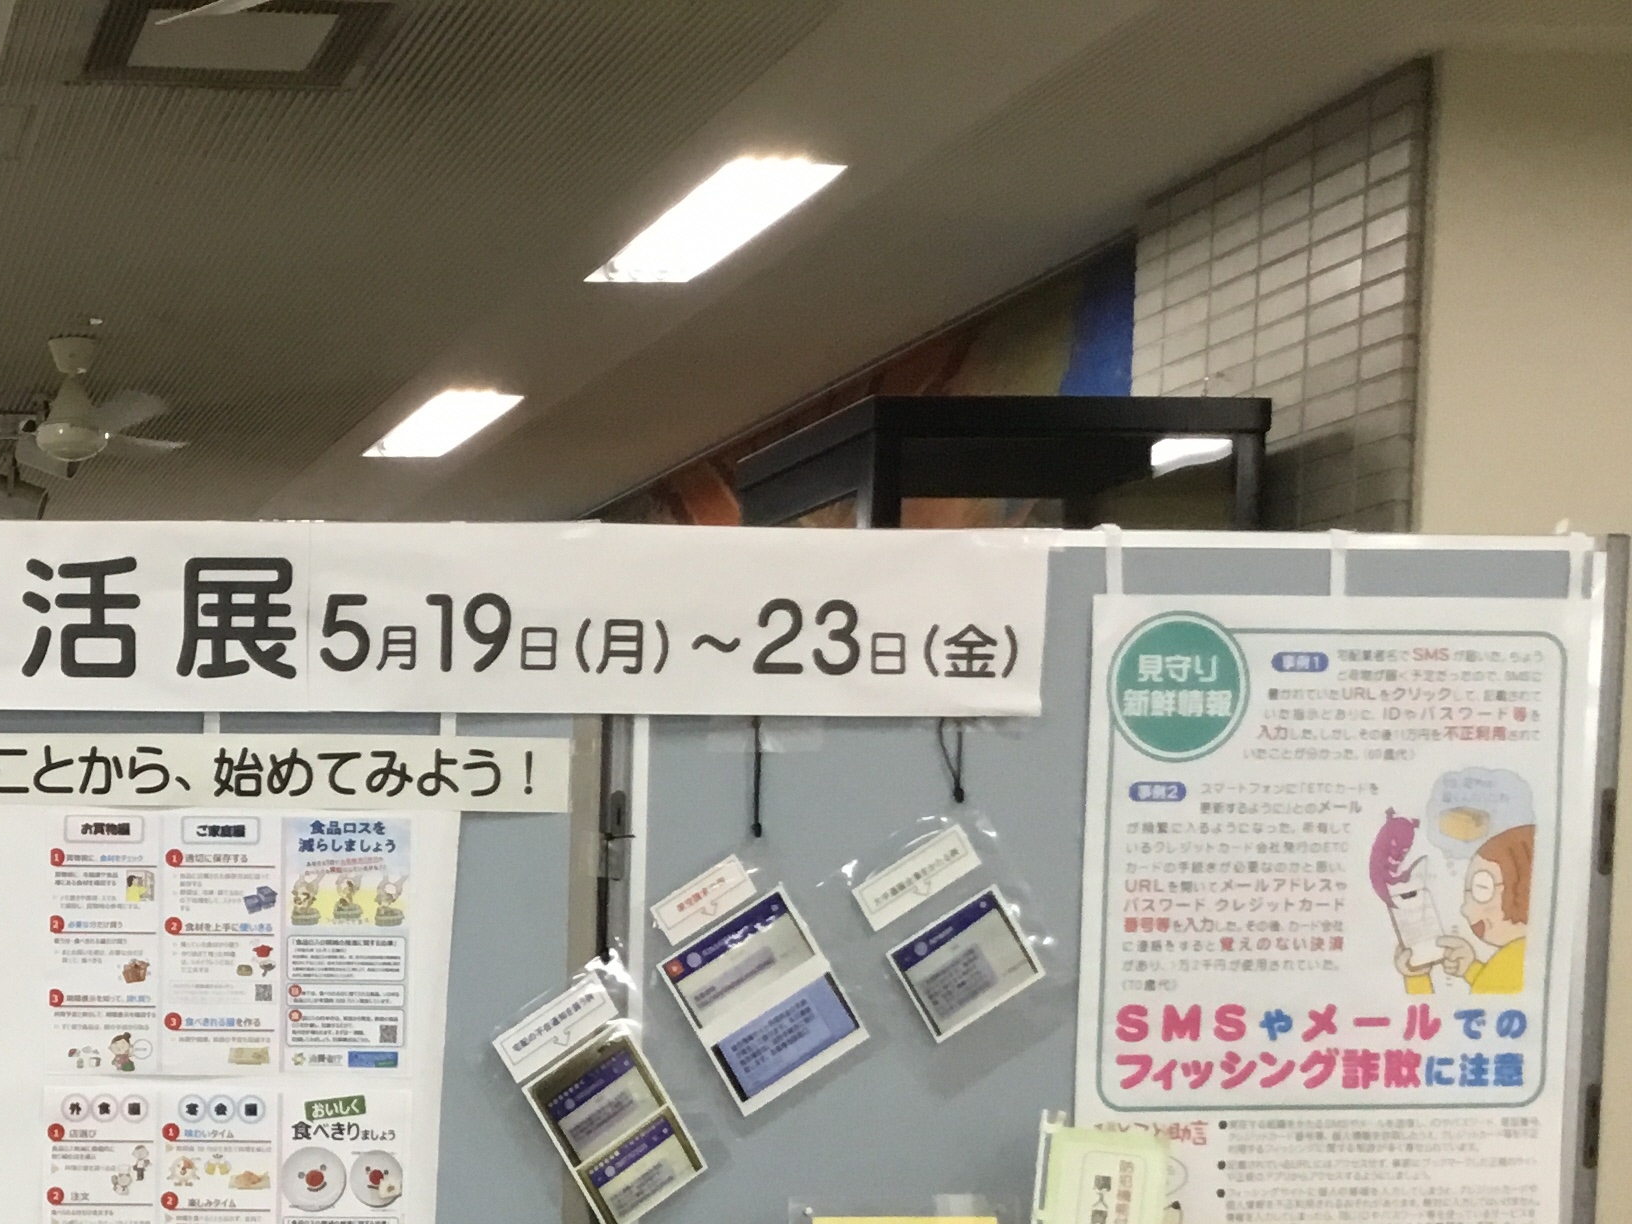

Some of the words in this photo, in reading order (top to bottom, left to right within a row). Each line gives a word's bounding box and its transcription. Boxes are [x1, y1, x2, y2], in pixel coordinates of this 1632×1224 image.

[1137, 654, 1219, 683] 見守り
[1122, 690, 1232, 718] 新鮮情報
[309, 820, 386, 836] 食品ロスを
[298, 838, 397, 853] 減らしましょう
[1115, 1003, 1527, 1042] SMSやメールでの
[1115, 1050, 1524, 1090] フィッシング詐欺に注意
[311, 1097, 361, 1119] おいしく
[291, 1121, 396, 1141] 食べきりましょう
